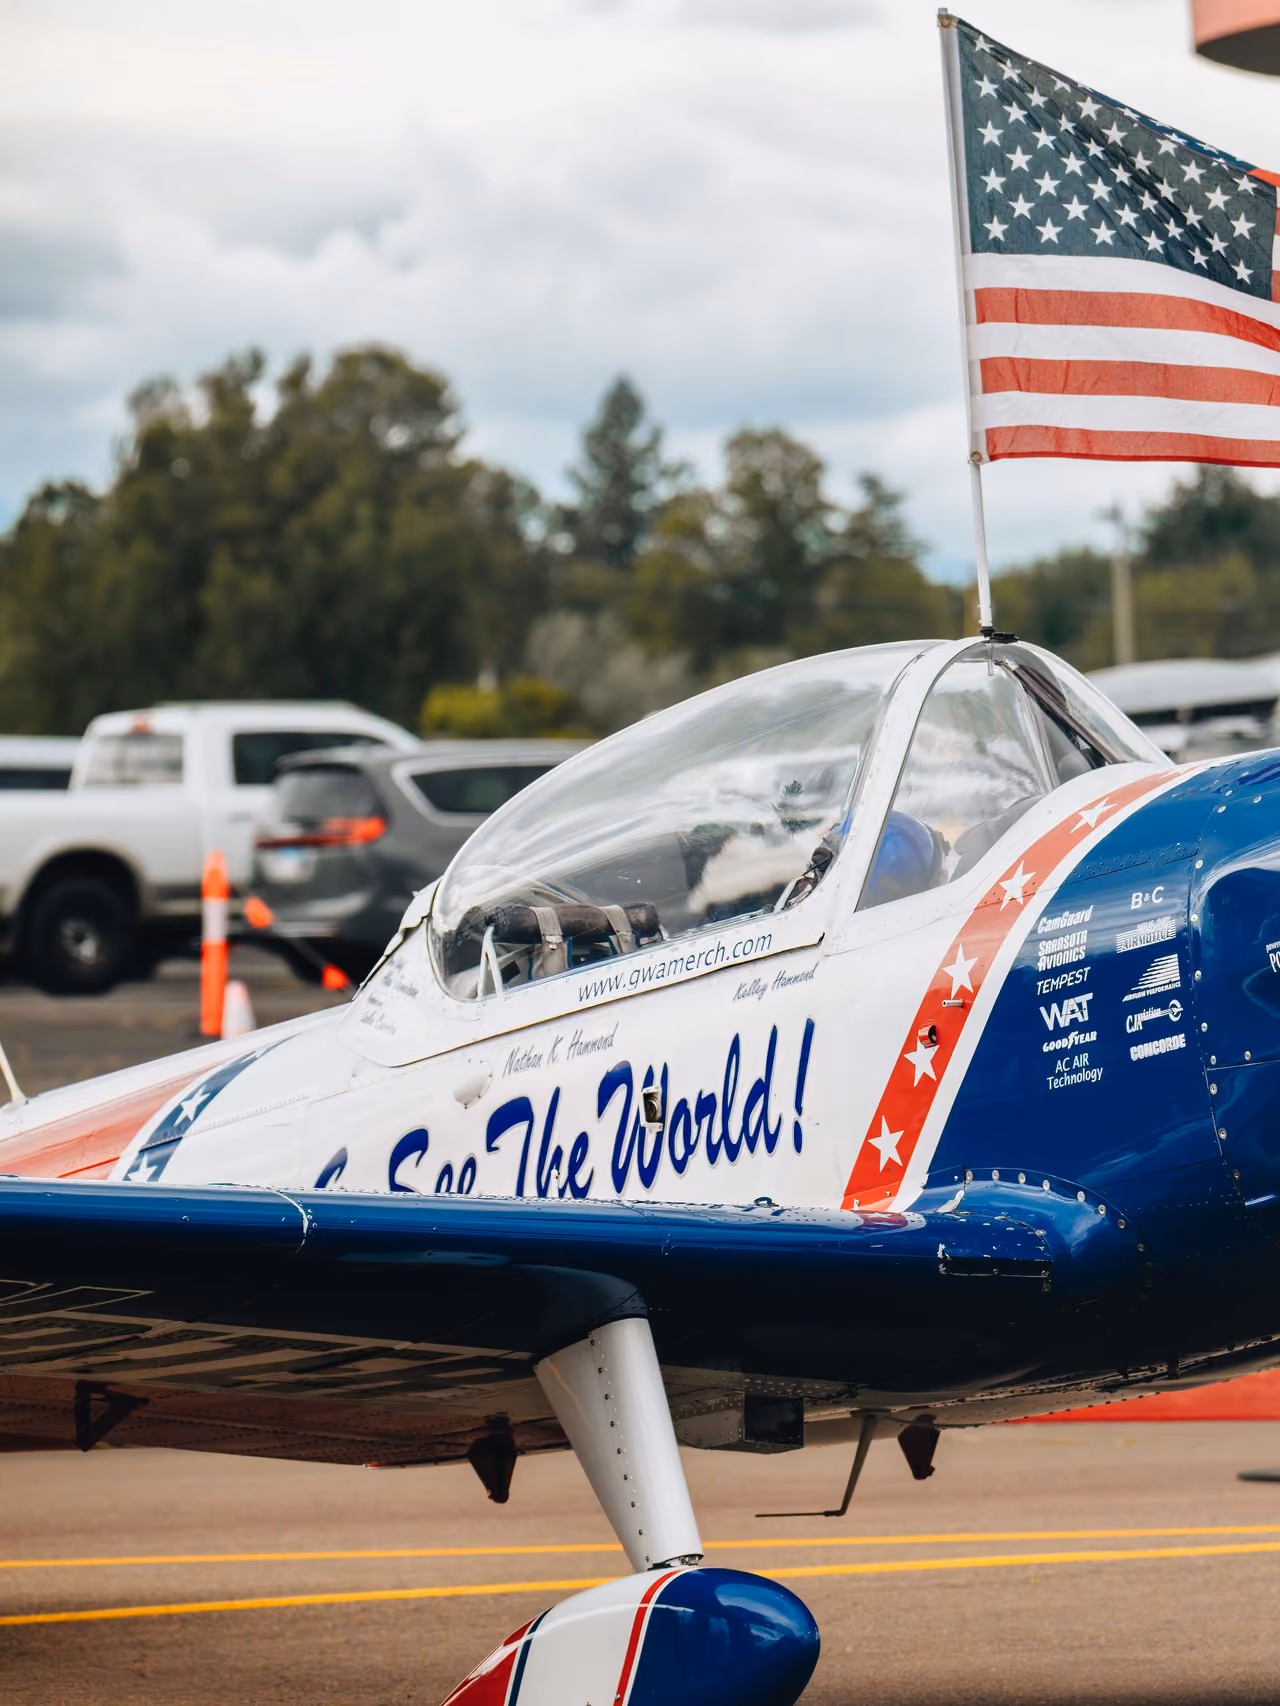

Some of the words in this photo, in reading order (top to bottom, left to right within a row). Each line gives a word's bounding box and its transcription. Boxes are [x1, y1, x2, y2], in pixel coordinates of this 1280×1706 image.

[1130, 886, 1165, 910] B&C
[1037, 905, 1094, 934] CamGuard
[1038, 930, 1088, 957] SARASOTA
[578, 932, 773, 1002] www.gwamerch.com
[1037, 946, 1087, 972] AVIONICS
[733, 977, 768, 1002] Kelley
[771, 960, 820, 992] Hammond
[1036, 966, 1091, 996] TEMPEST
[1147, 981, 1182, 996] PERFORMANCE
[1039, 992, 1094, 1031] WAT
[502, 1046, 543, 1078] Nathan
[547, 1035, 563, 1064] K.
[566, 1022, 620, 1061] Hammond
[1042, 1031, 1098, 1053] GOODYEAR
[1129, 1033, 1187, 1061] CONCORDE
[1055, 1057, 1070, 1074] AC
[1072, 1053, 1090, 1070] AIR
[1047, 1067, 1103, 1090] Technology
[486, 1086, 594, 1199] The
[597, 1016, 817, 1195] World!
